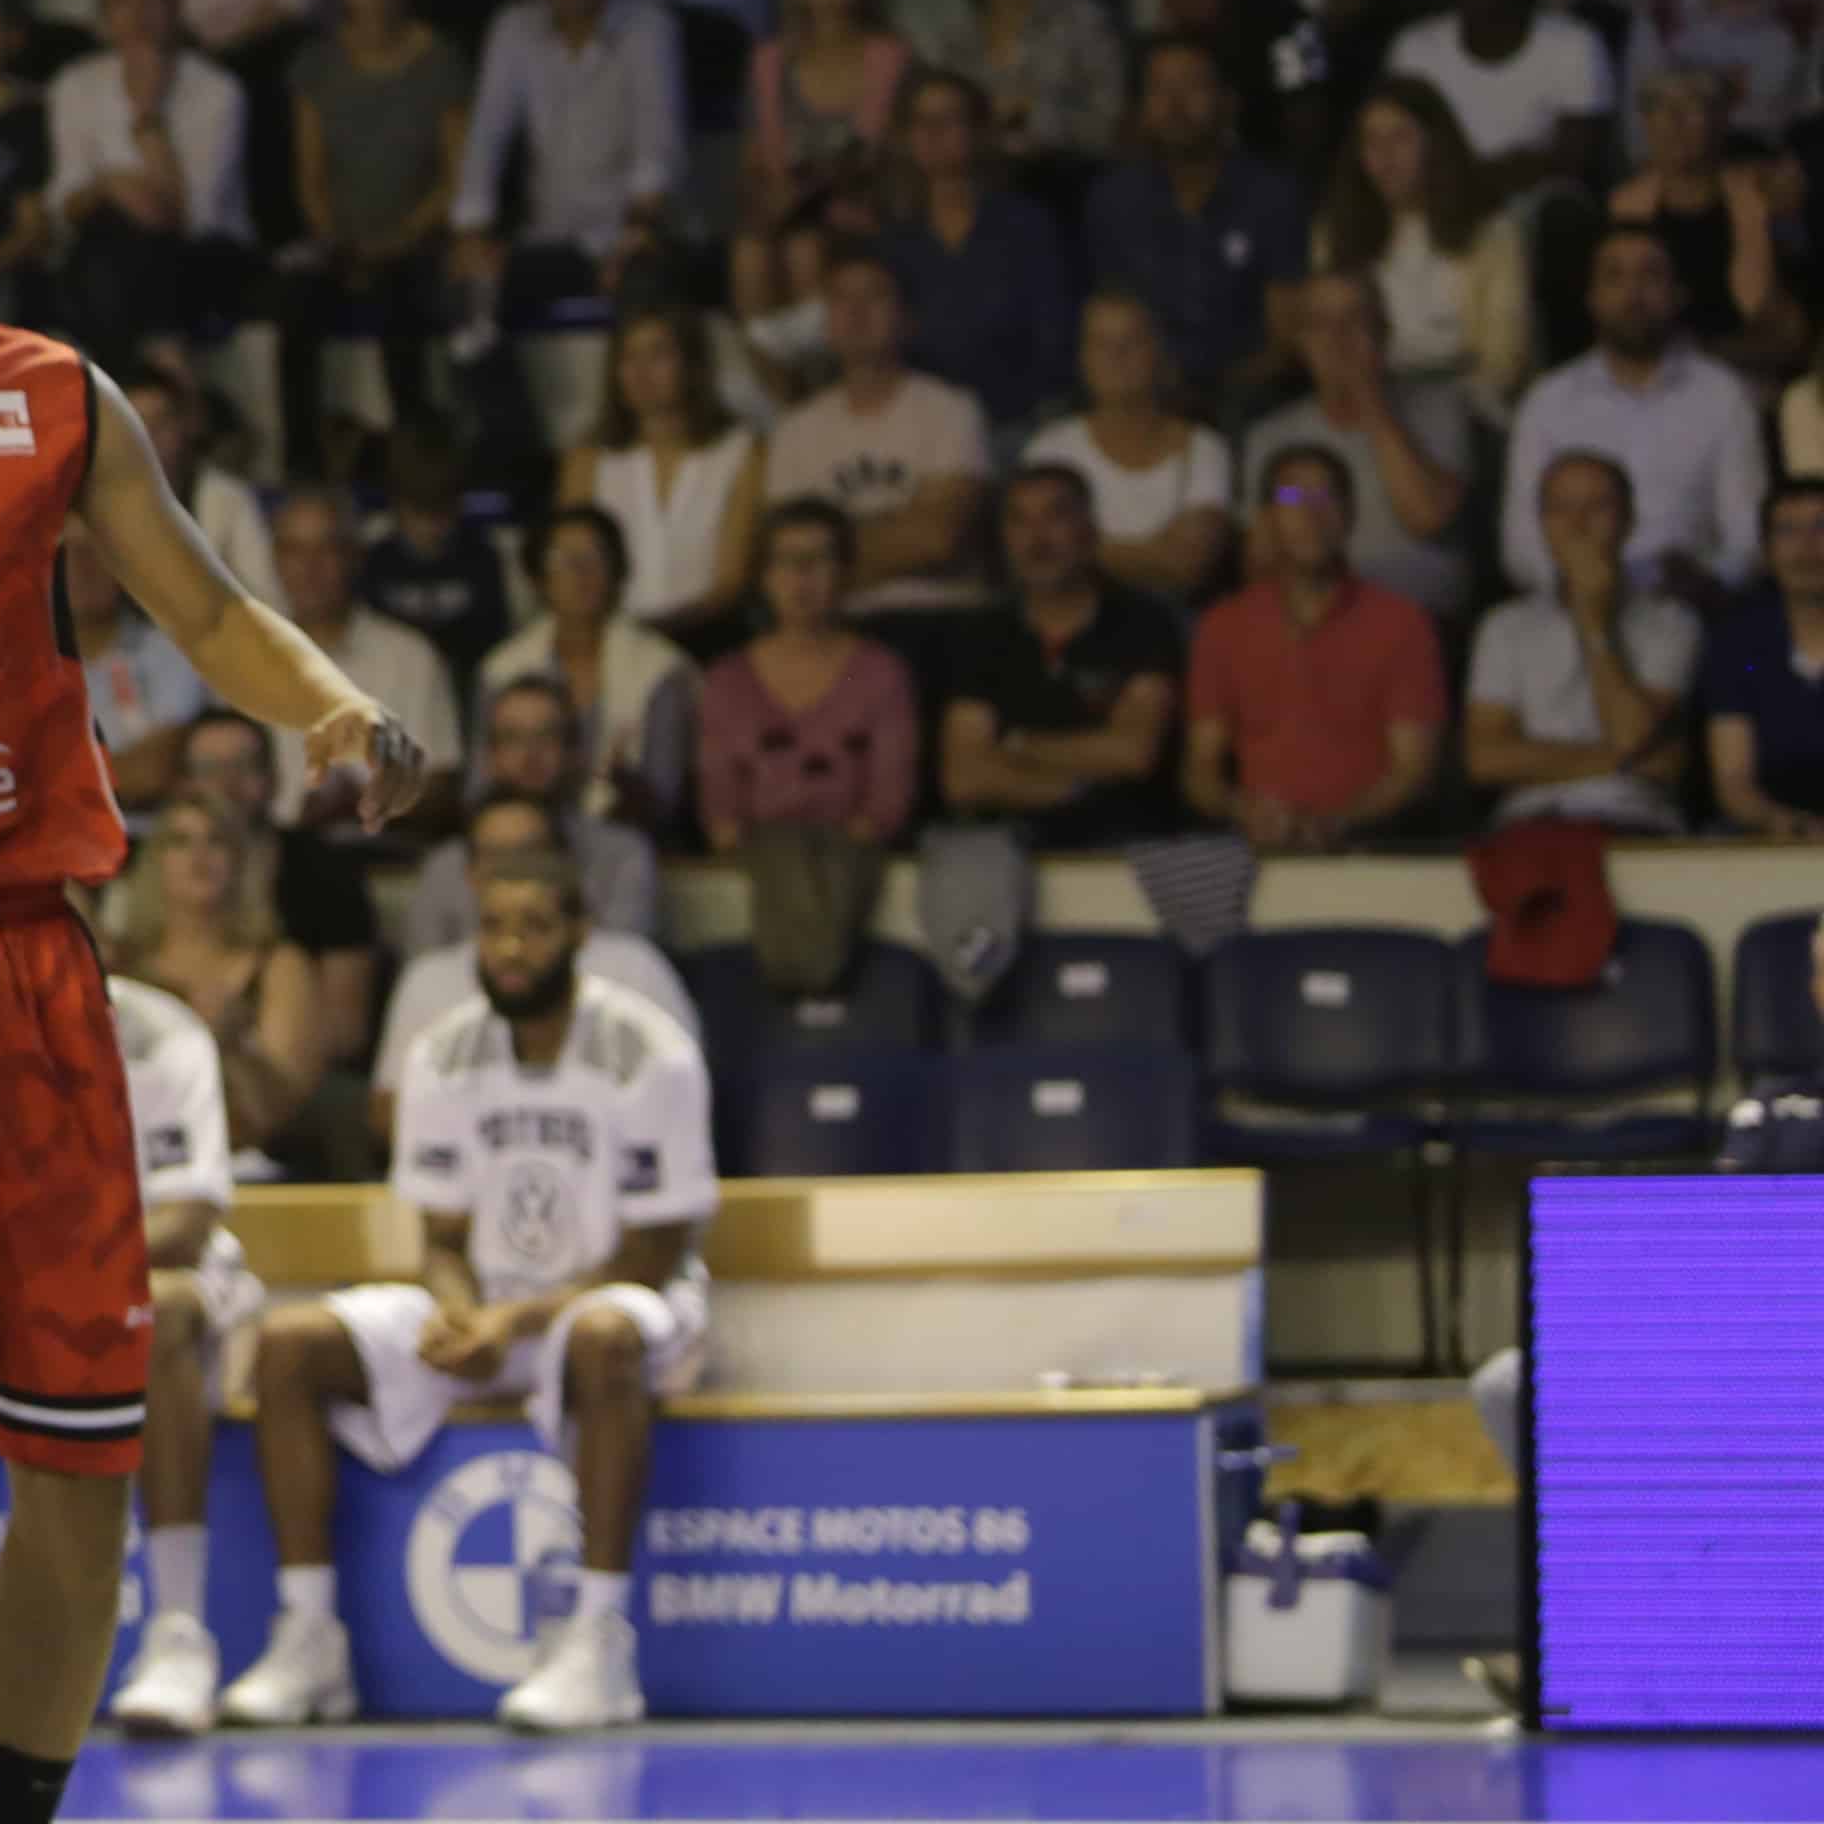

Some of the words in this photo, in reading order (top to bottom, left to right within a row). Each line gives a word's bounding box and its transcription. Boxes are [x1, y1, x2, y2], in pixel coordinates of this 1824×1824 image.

[648, 1506, 806, 1557] ESPACE
[811, 1504, 970, 1558] MOTOS
[972, 1505, 1031, 1556] 86
[650, 1572, 783, 1628] BMW
[789, 1568, 1031, 1627] Motorrad
